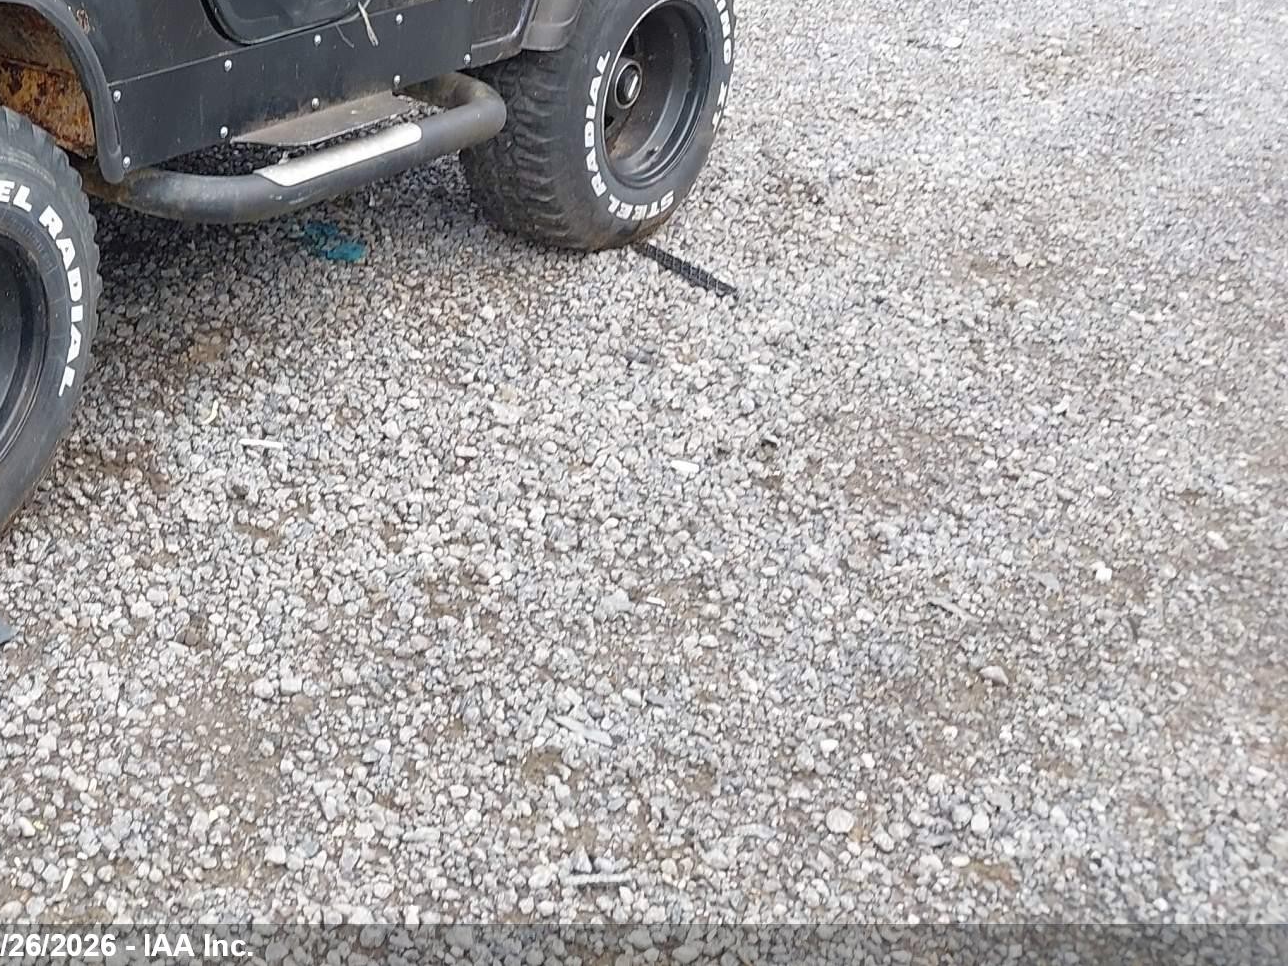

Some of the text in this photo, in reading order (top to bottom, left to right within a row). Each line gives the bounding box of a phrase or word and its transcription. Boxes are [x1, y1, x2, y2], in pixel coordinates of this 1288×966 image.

[584, 50, 675, 222] STEEL RADIAL
[38, 205, 87, 397] RADIAL
